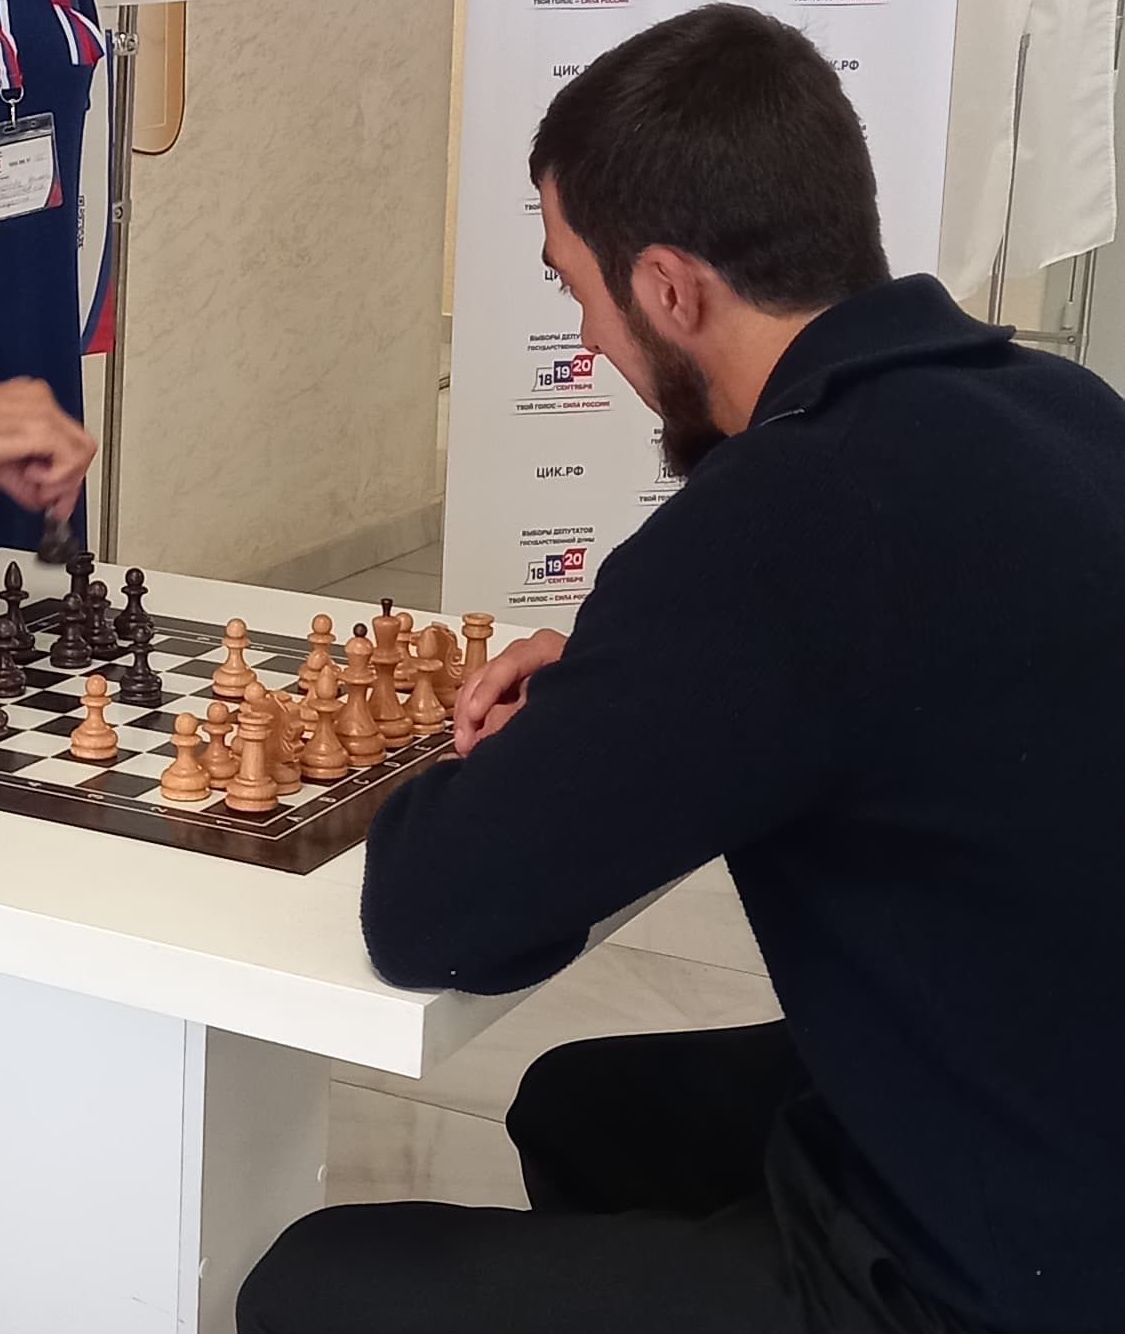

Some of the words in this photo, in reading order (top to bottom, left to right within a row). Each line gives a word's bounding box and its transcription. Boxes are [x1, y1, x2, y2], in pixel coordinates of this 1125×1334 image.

[539, 374, 552, 386] 18
[555, 366, 570, 379] 19
[573, 359, 591, 372] 20
[536, 466, 584, 478] ЦИК.РФ
[531, 568, 544, 579] 18
[547, 560, 562, 572] 19
[564, 553, 582, 565] 20
